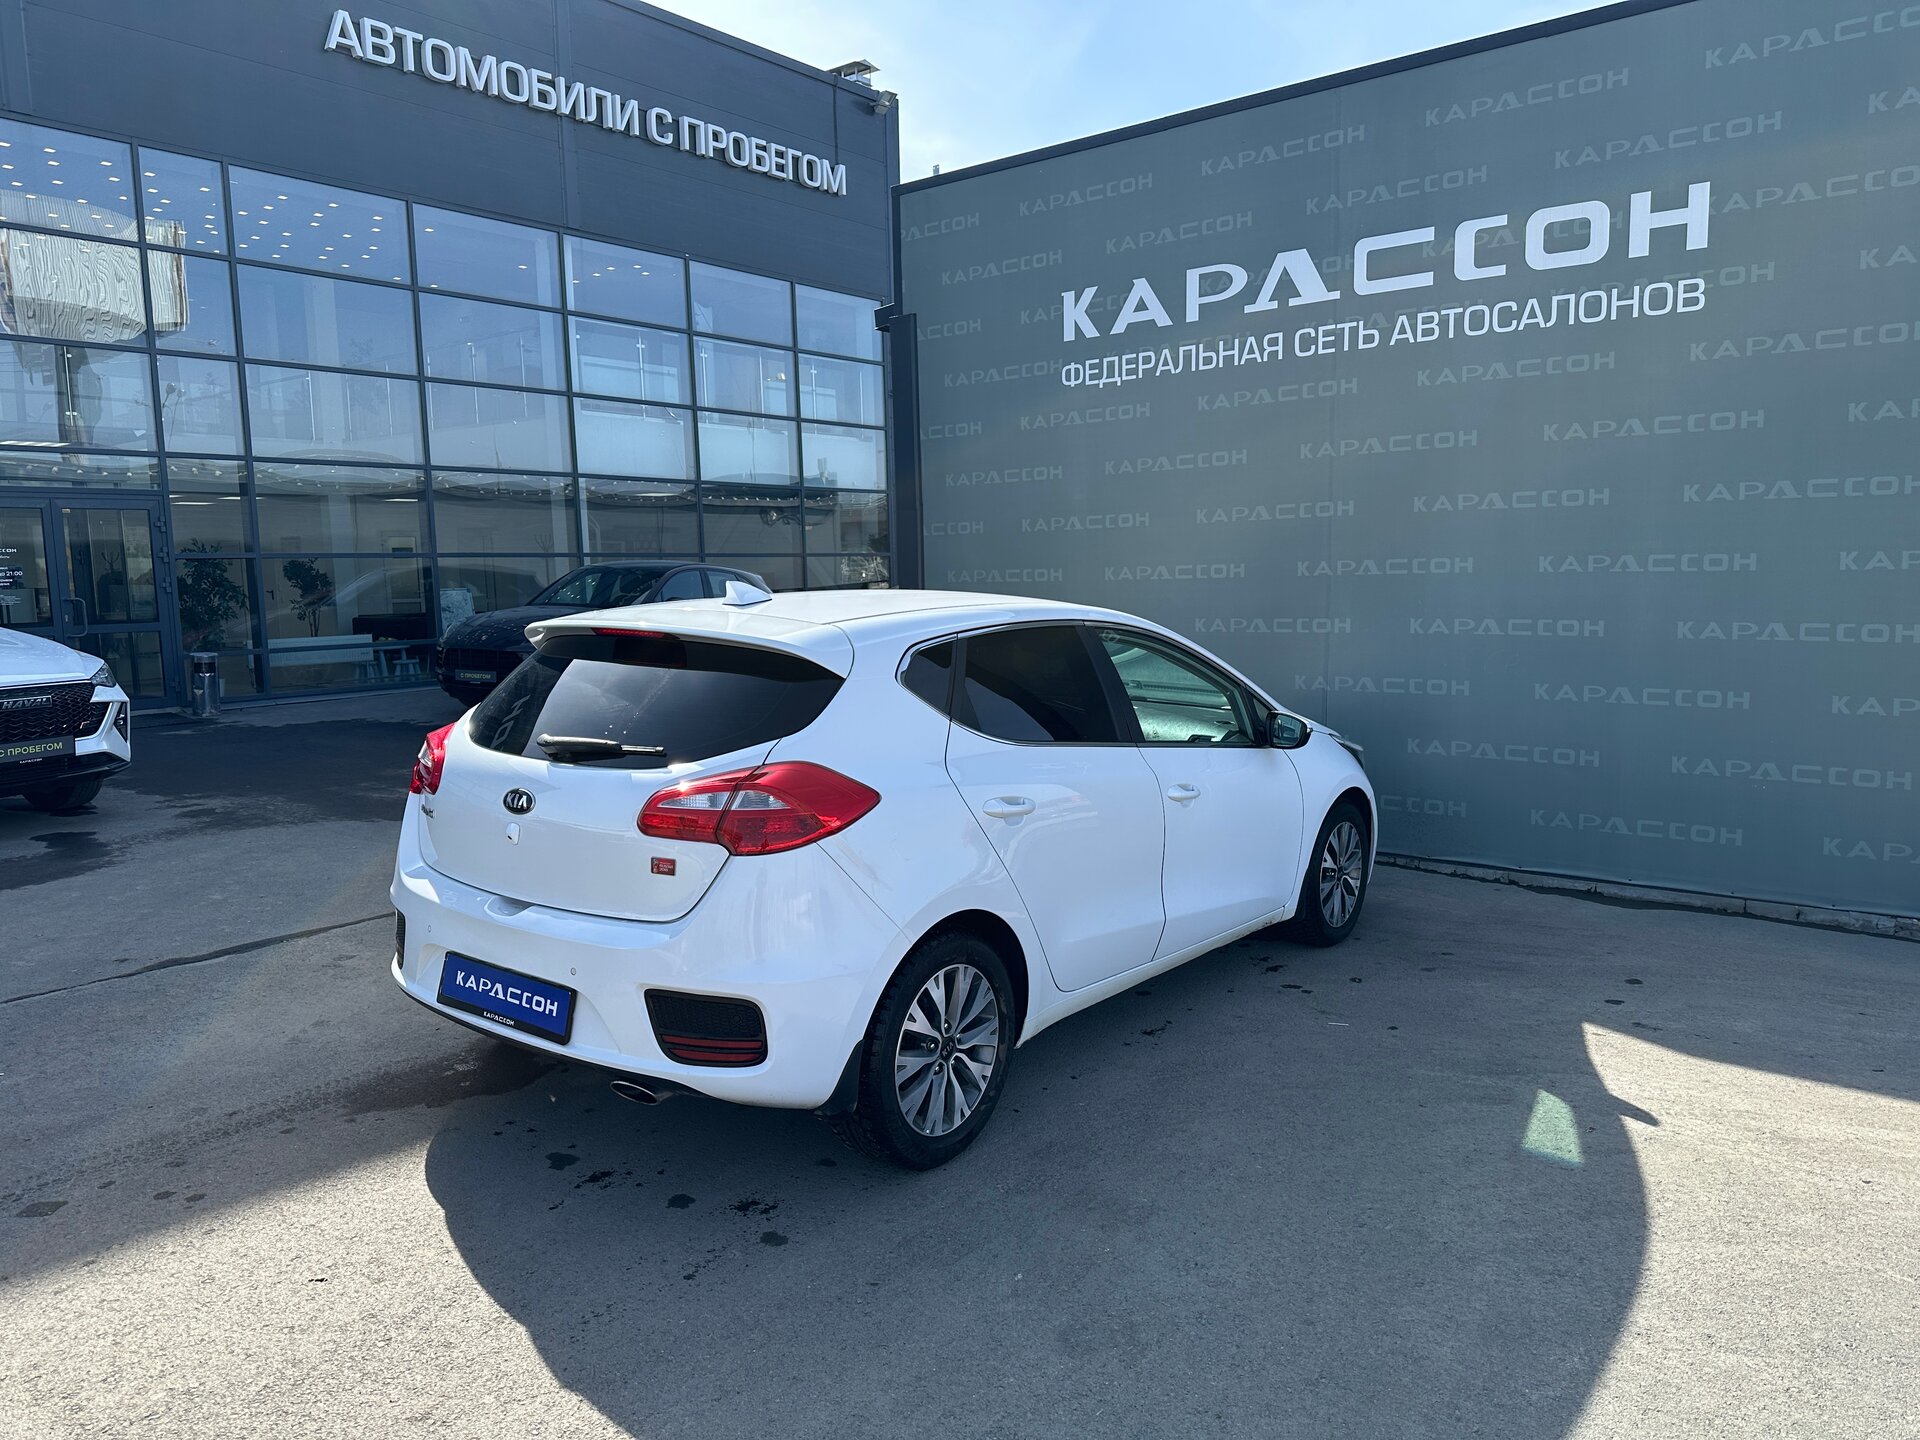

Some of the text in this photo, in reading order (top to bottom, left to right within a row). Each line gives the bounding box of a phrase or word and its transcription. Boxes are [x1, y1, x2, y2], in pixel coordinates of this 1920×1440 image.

[324, 9, 847, 197] АВТОМОБИЛИ С ПРОБЕГОМ
[1061, 181, 1711, 342] КАРАССОН
[1061, 278, 1706, 388] ФЕДЕРАЛЬНАЯ СЕТЬ АВТОСАЛОНОВ
[1690, 321, 1920, 361] КАРАССО
[2, 697, 49, 710] HAVAL
[7, 742, 63, 757] ПРОБЕГОМ
[505, 792, 528, 810] KIA
[455, 970, 558, 1017] КАРАССОН
